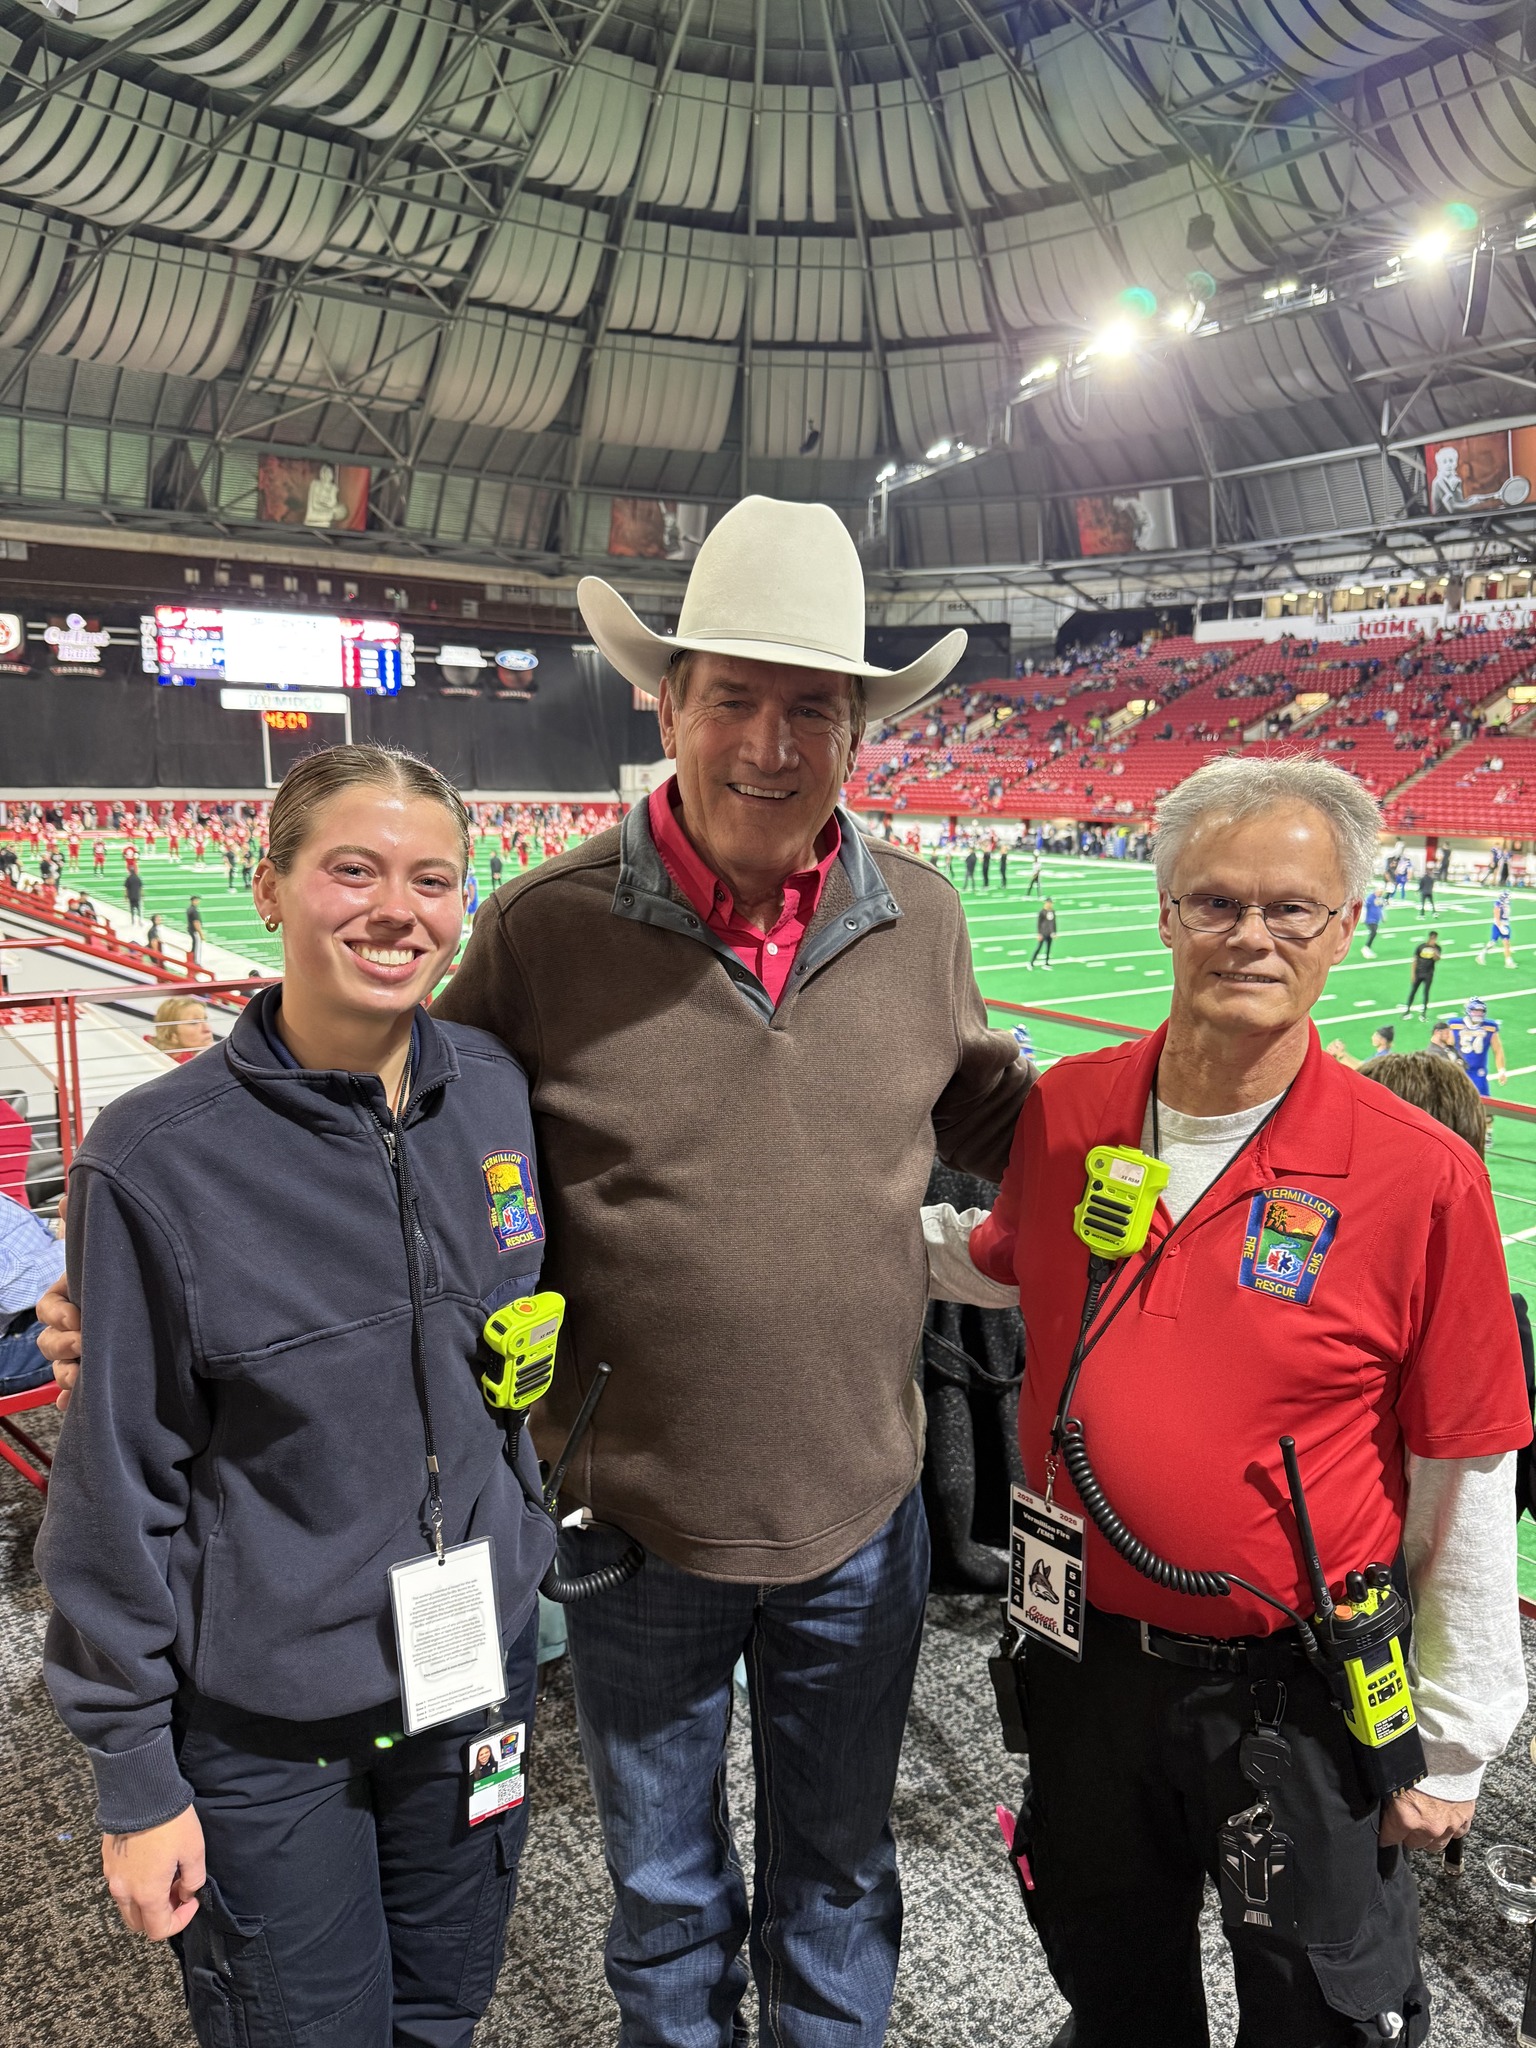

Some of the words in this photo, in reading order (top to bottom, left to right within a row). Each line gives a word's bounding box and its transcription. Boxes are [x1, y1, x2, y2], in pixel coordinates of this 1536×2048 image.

[1358, 618, 1417, 637] HOME
[481, 1154, 522, 1172] VERMILLION
[1263, 1189, 1334, 1219] VERMILLION
[505, 1232, 536, 1247] RESCUE
[1243, 1235, 1256, 1260] FIRE
[1307, 1253, 1323, 1275] EMS
[1255, 1278, 1296, 1299] RESCUE
[1023, 1511, 1056, 1533] Vermillion
[1056, 1528, 1071, 1540] Fire
[1015, 1543, 1021, 1551] 1
[1015, 1560, 1021, 1569] 2
[1014, 1576, 1021, 1586] 3
[1069, 1571, 1076, 1581] 5
[1068, 1589, 1076, 1598] 6
[1029, 1605, 1058, 1628] Coyote
[1067, 1606, 1075, 1615] 7
[1025, 1610, 1061, 1637] FOOTBALL
[1067, 1624, 1075, 1633] 8
